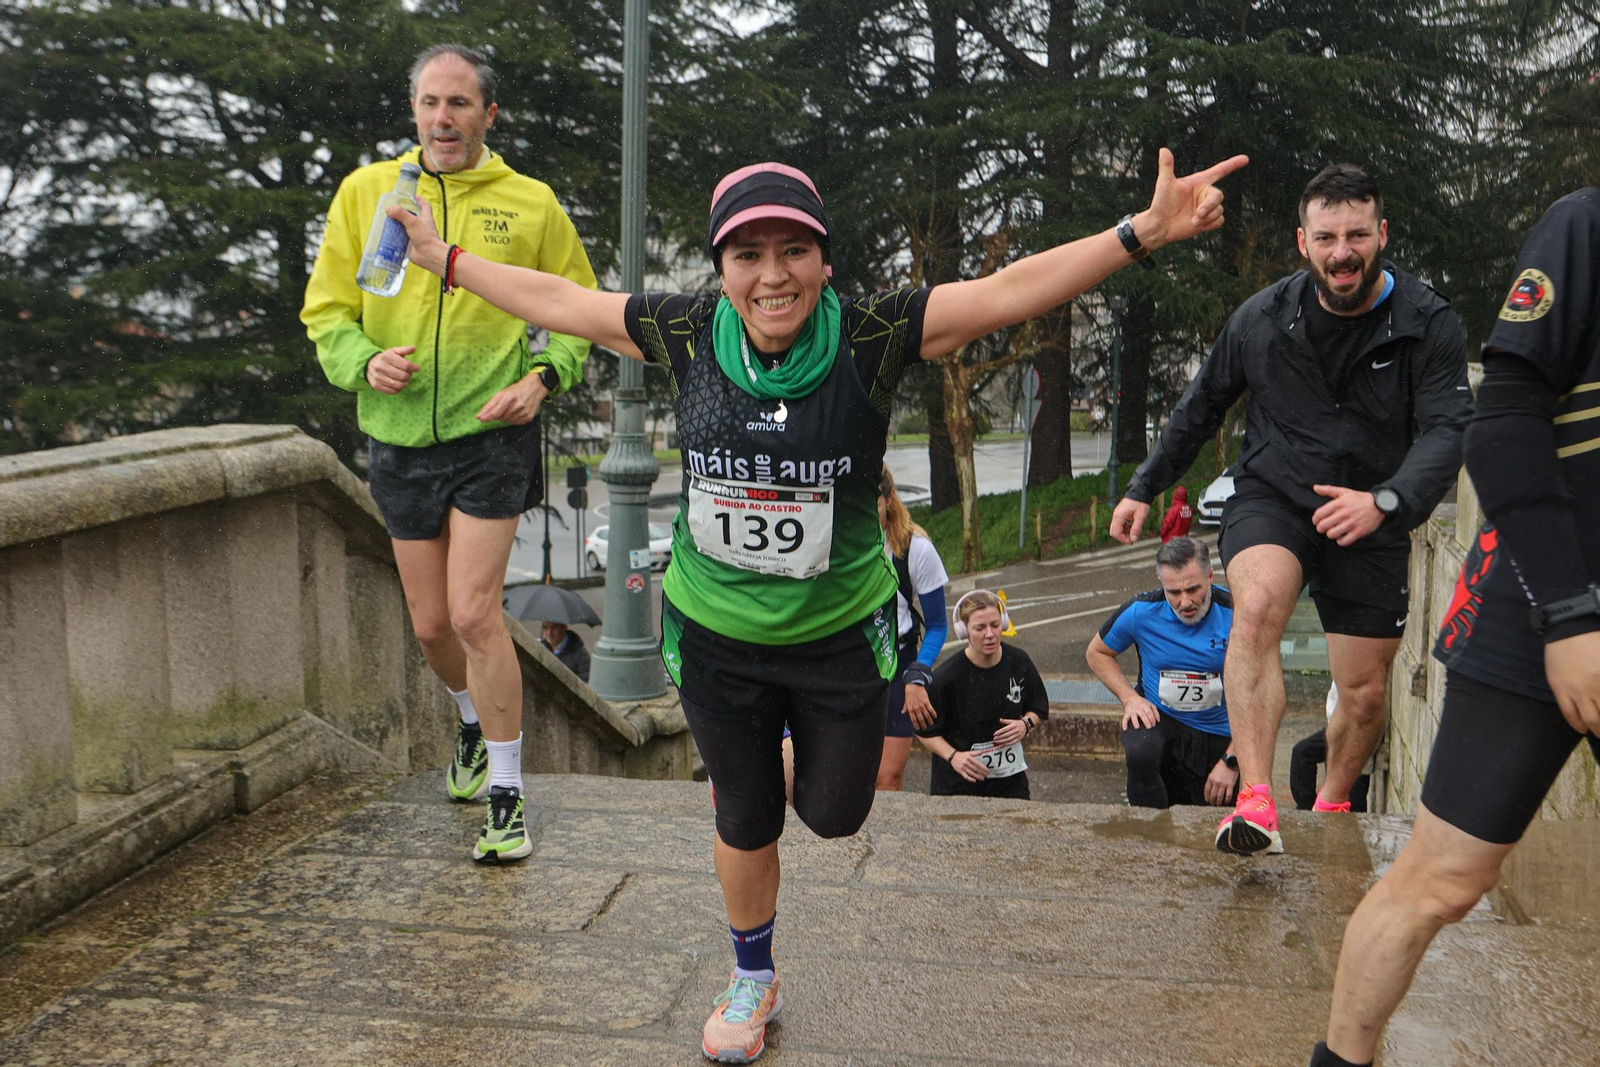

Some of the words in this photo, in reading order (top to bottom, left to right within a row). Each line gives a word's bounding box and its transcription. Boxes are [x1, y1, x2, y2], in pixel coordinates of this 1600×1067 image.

[484, 235, 510, 245] VIGO
[746, 419, 786, 432] amura
[688, 447, 750, 480] máis
[755, 453, 776, 485] que
[780, 455, 852, 488] auga
[713, 498, 747, 510] SUBIDA
[749, 503, 762, 511] AO
[763, 503, 802, 513] CASTRO
[714, 511, 805, 554] 139
[1177, 685, 1204, 702] 73
[982, 747, 1016, 769] 276
